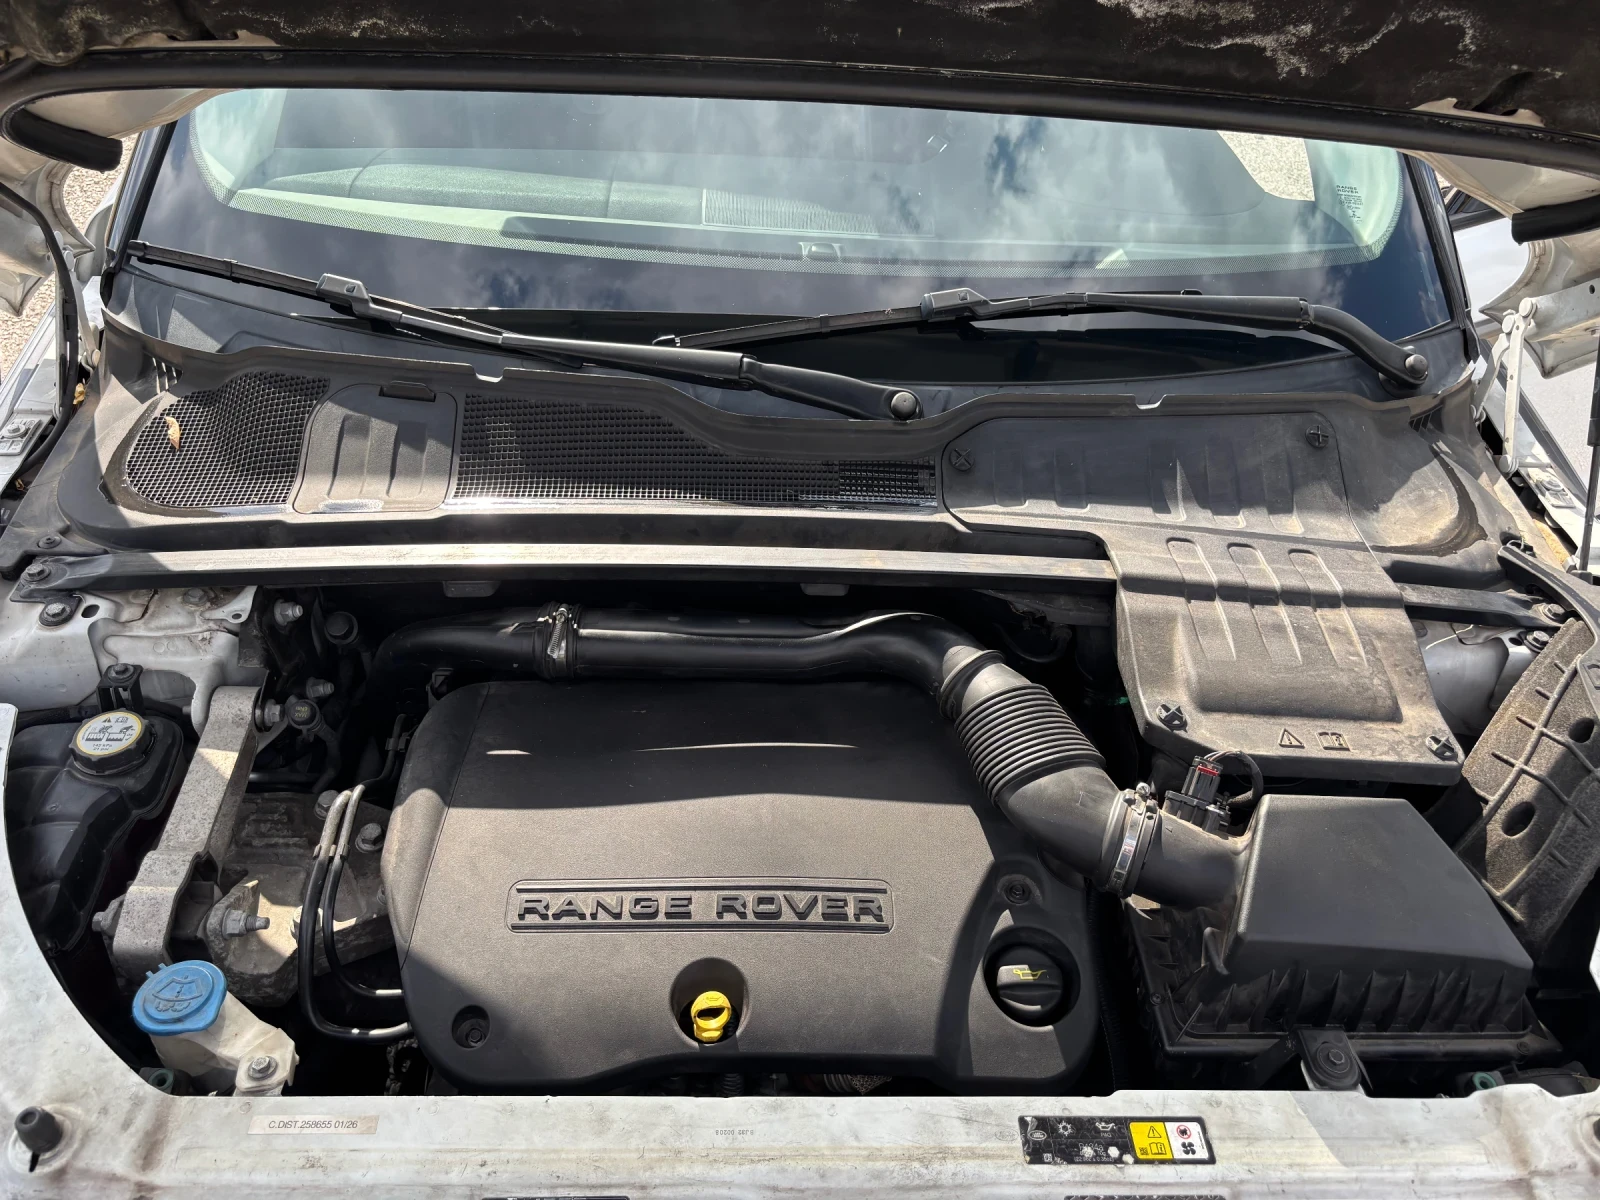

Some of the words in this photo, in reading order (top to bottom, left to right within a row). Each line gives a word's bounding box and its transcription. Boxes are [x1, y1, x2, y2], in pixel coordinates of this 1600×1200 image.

[517, 893, 692, 921] RANGE
[715, 892, 885, 923] ROVER
[268, 1120, 332, 1129] C.DIST.258655
[334, 1120, 358, 1129] 01/26
